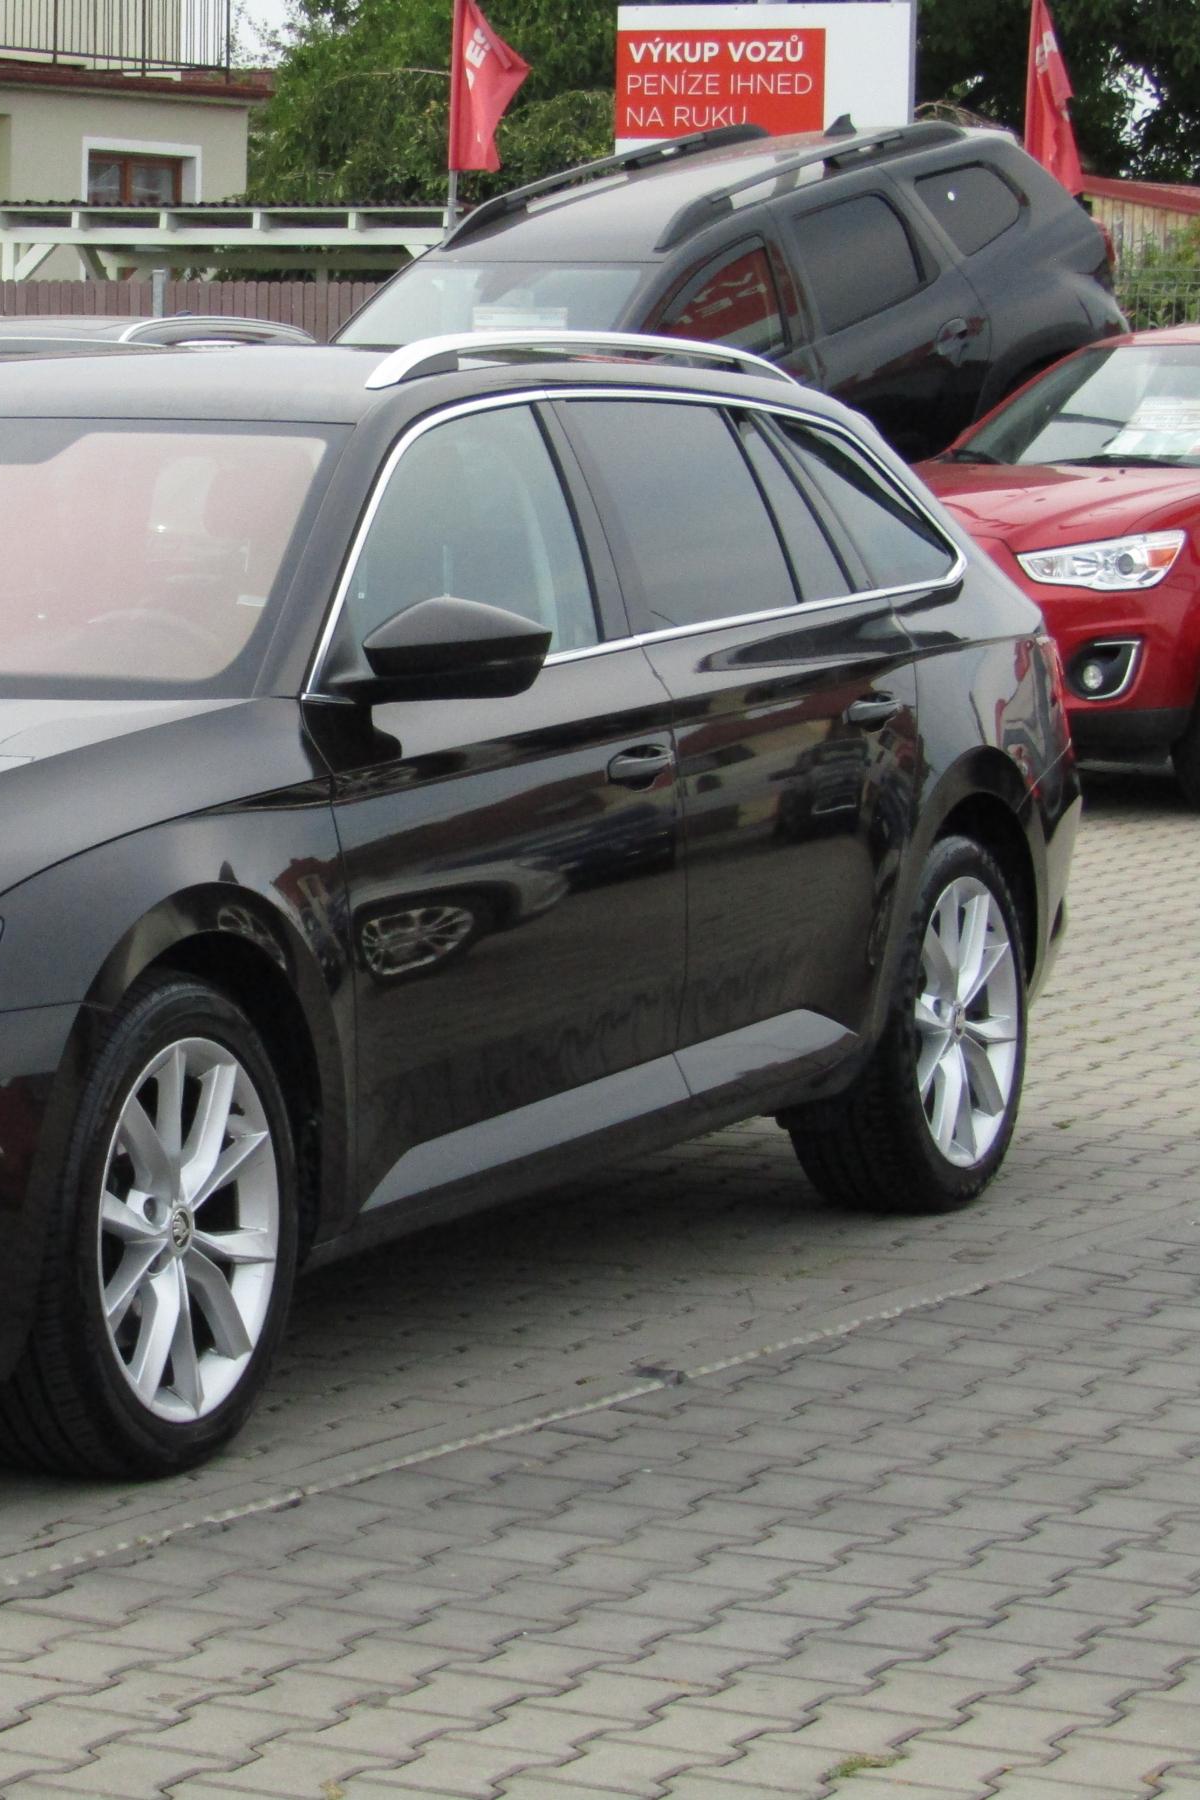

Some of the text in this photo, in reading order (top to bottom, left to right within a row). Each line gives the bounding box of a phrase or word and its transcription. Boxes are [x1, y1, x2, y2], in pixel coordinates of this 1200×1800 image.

[628, 34, 804, 63] VÝKUP VOZŮ
[626, 69, 813, 96] PENÍZE IHNED
[626, 106, 748, 127] NA RUKU
